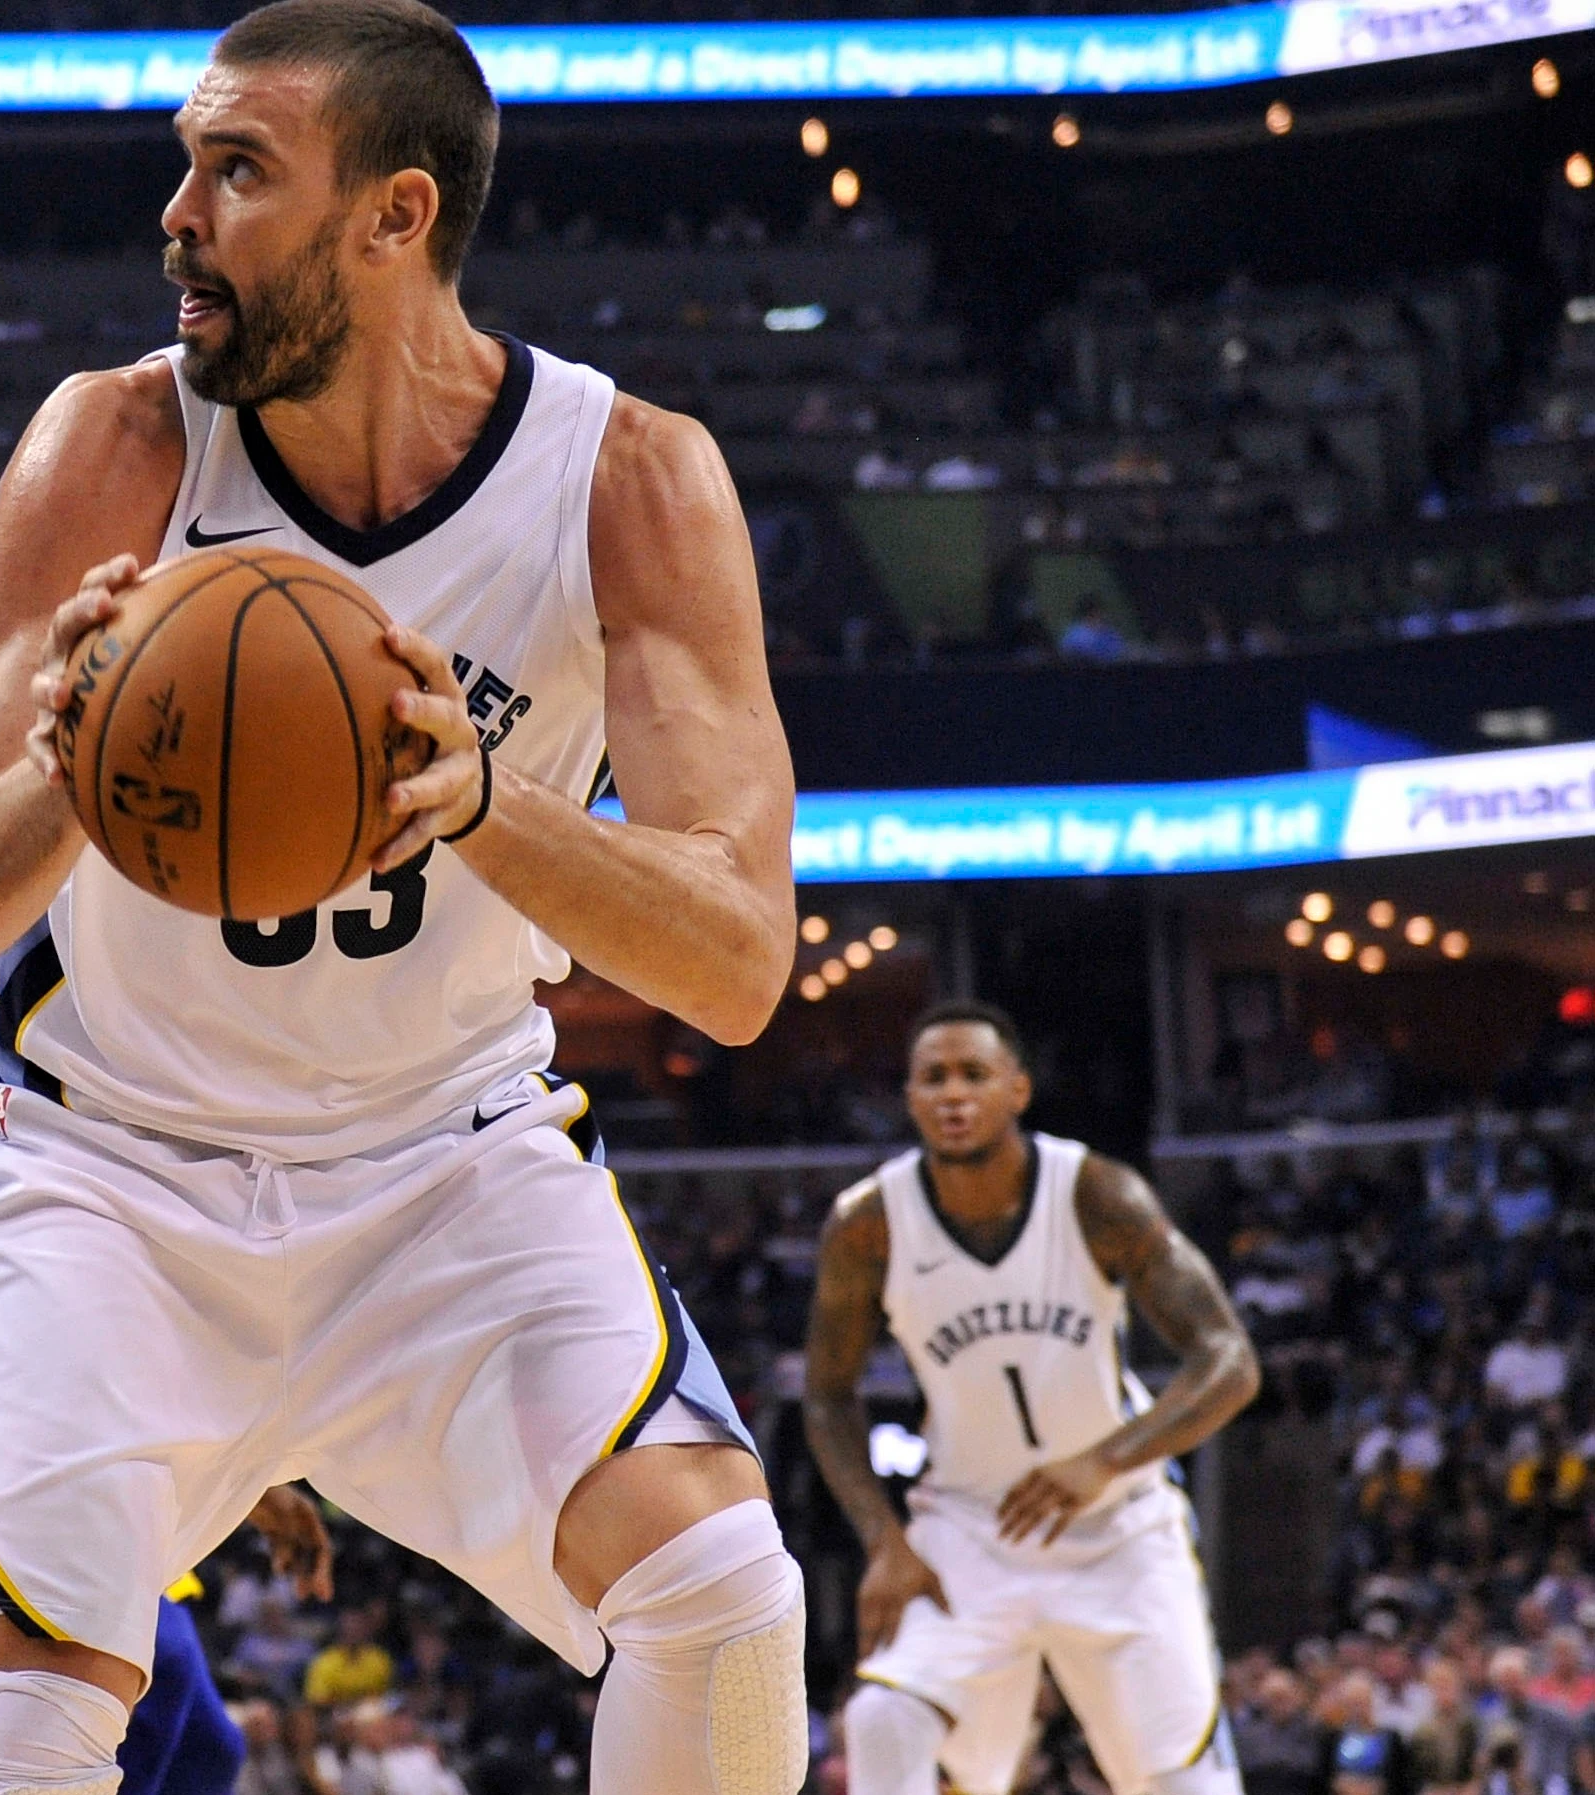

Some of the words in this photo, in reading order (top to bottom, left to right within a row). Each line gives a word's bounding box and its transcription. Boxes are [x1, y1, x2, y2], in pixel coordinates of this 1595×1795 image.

[565, 44, 653, 91] and
[657, 55, 686, 90] a
[692, 40, 828, 89] Direct
[836, 38, 1005, 97] Deposit
[1013, 38, 1068, 94] by
[1075, 35, 1186, 93] April
[1194, 31, 1260, 77] 1st
[868, 813, 1052, 877] Deposit
[1057, 811, 1121, 873] by
[1123, 805, 1246, 871] April
[1251, 800, 1322, 853] 1st
[1004, 1364, 1041, 1450] 1
